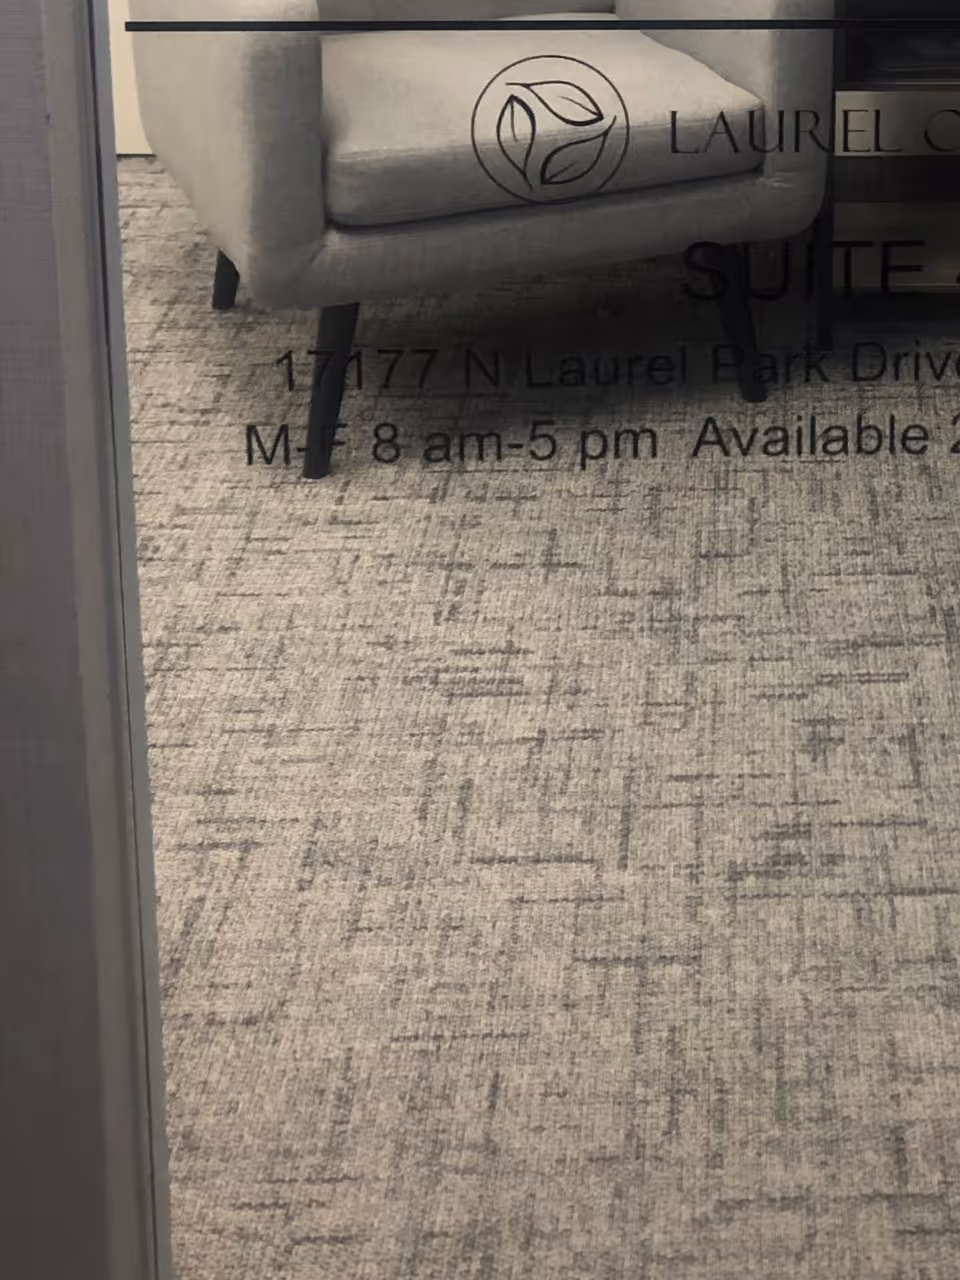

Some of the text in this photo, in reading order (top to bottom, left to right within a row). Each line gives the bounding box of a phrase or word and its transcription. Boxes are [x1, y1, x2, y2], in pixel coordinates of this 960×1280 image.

[669, 108, 903, 154] LAUREL
[683, 239, 927, 300] SUITE
[275, 348, 440, 392] 17177
[463, 348, 501, 389] N
[525, 344, 688, 389] Laurel
[711, 343, 830, 384] Park
[245, 422, 349, 466] M-F
[372, 421, 401, 464] 8
[422, 420, 559, 463] am-5
[577, 426, 657, 471] pm
[692, 414, 929, 458] Available
